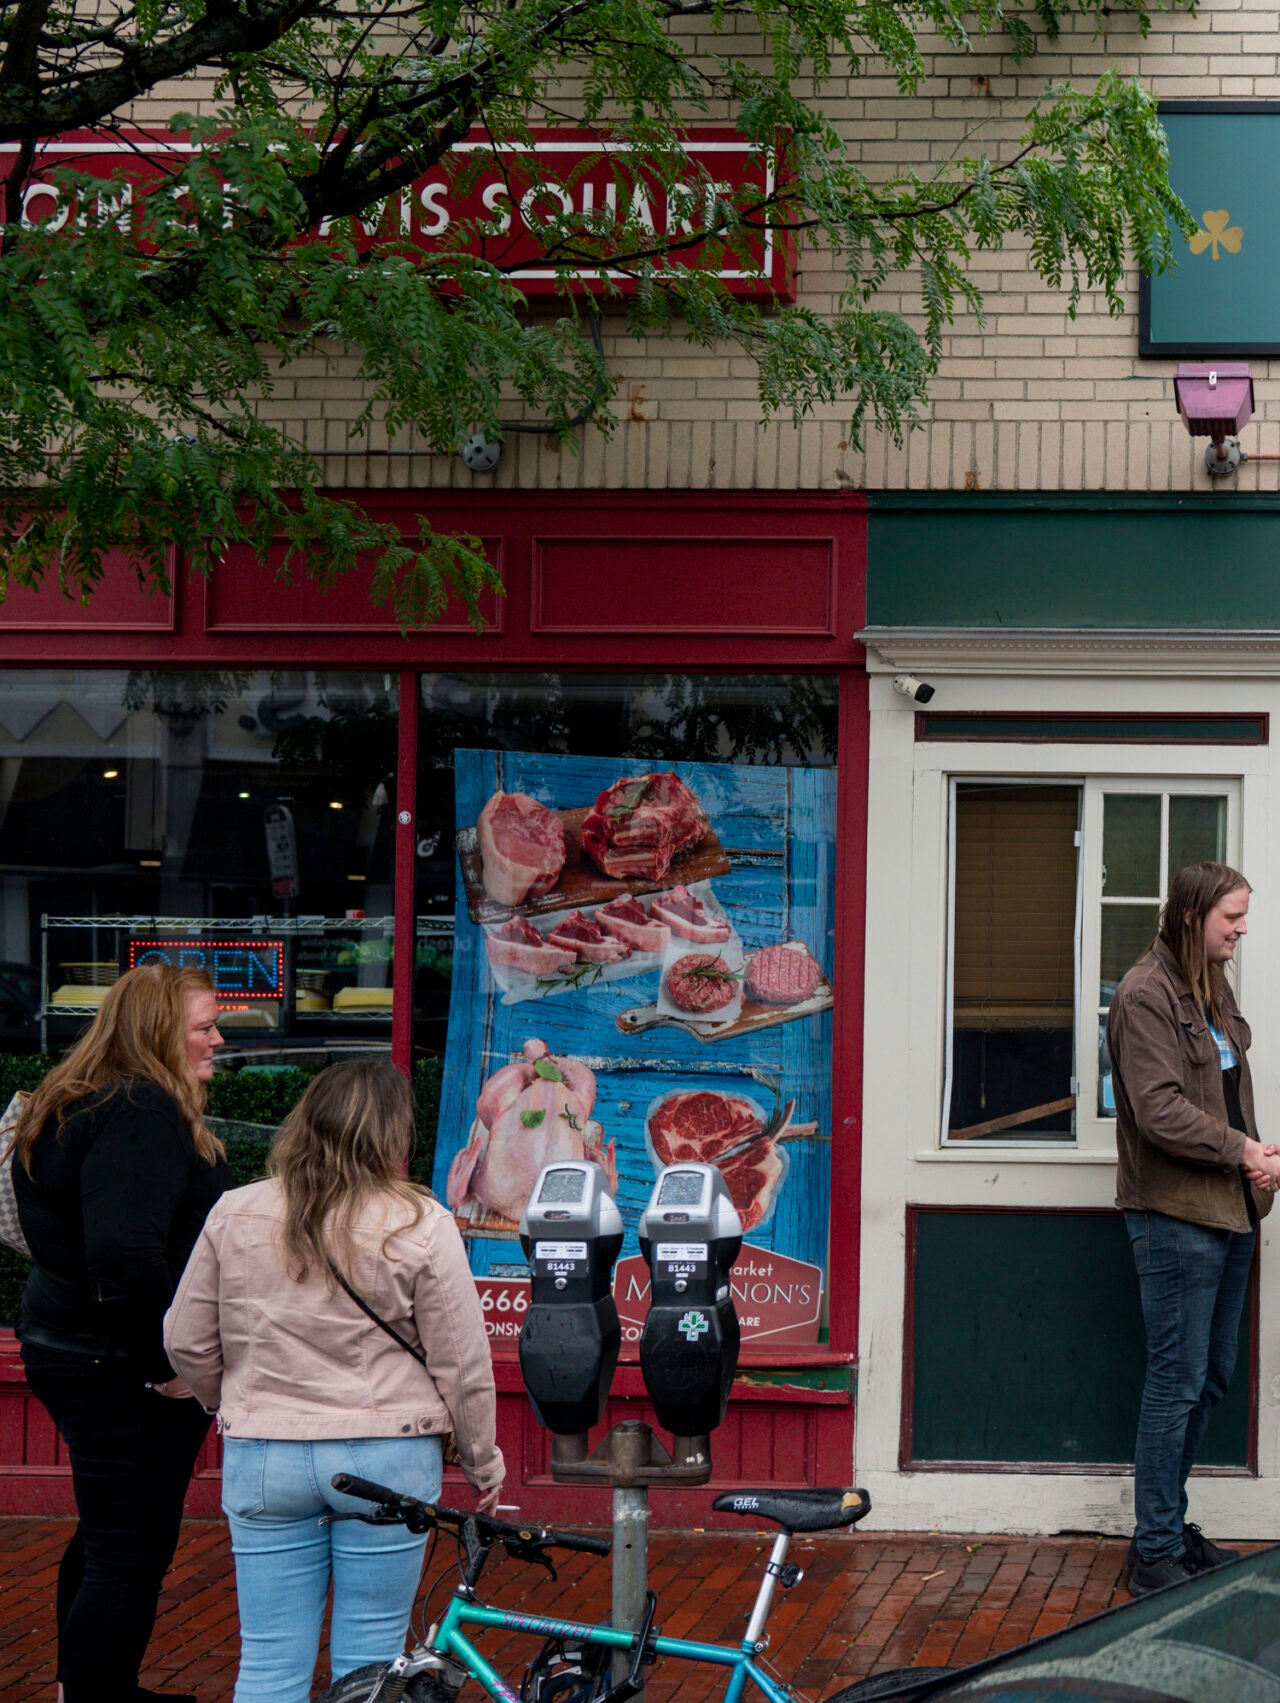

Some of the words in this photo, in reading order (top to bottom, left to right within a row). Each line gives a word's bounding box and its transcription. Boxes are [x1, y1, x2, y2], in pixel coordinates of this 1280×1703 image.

[547, 1262, 575, 1271] 81443
[668, 1264, 696, 1273] 81443
[738, 1316, 761, 1327] ARE
[733, 1497, 759, 1506] GEL
